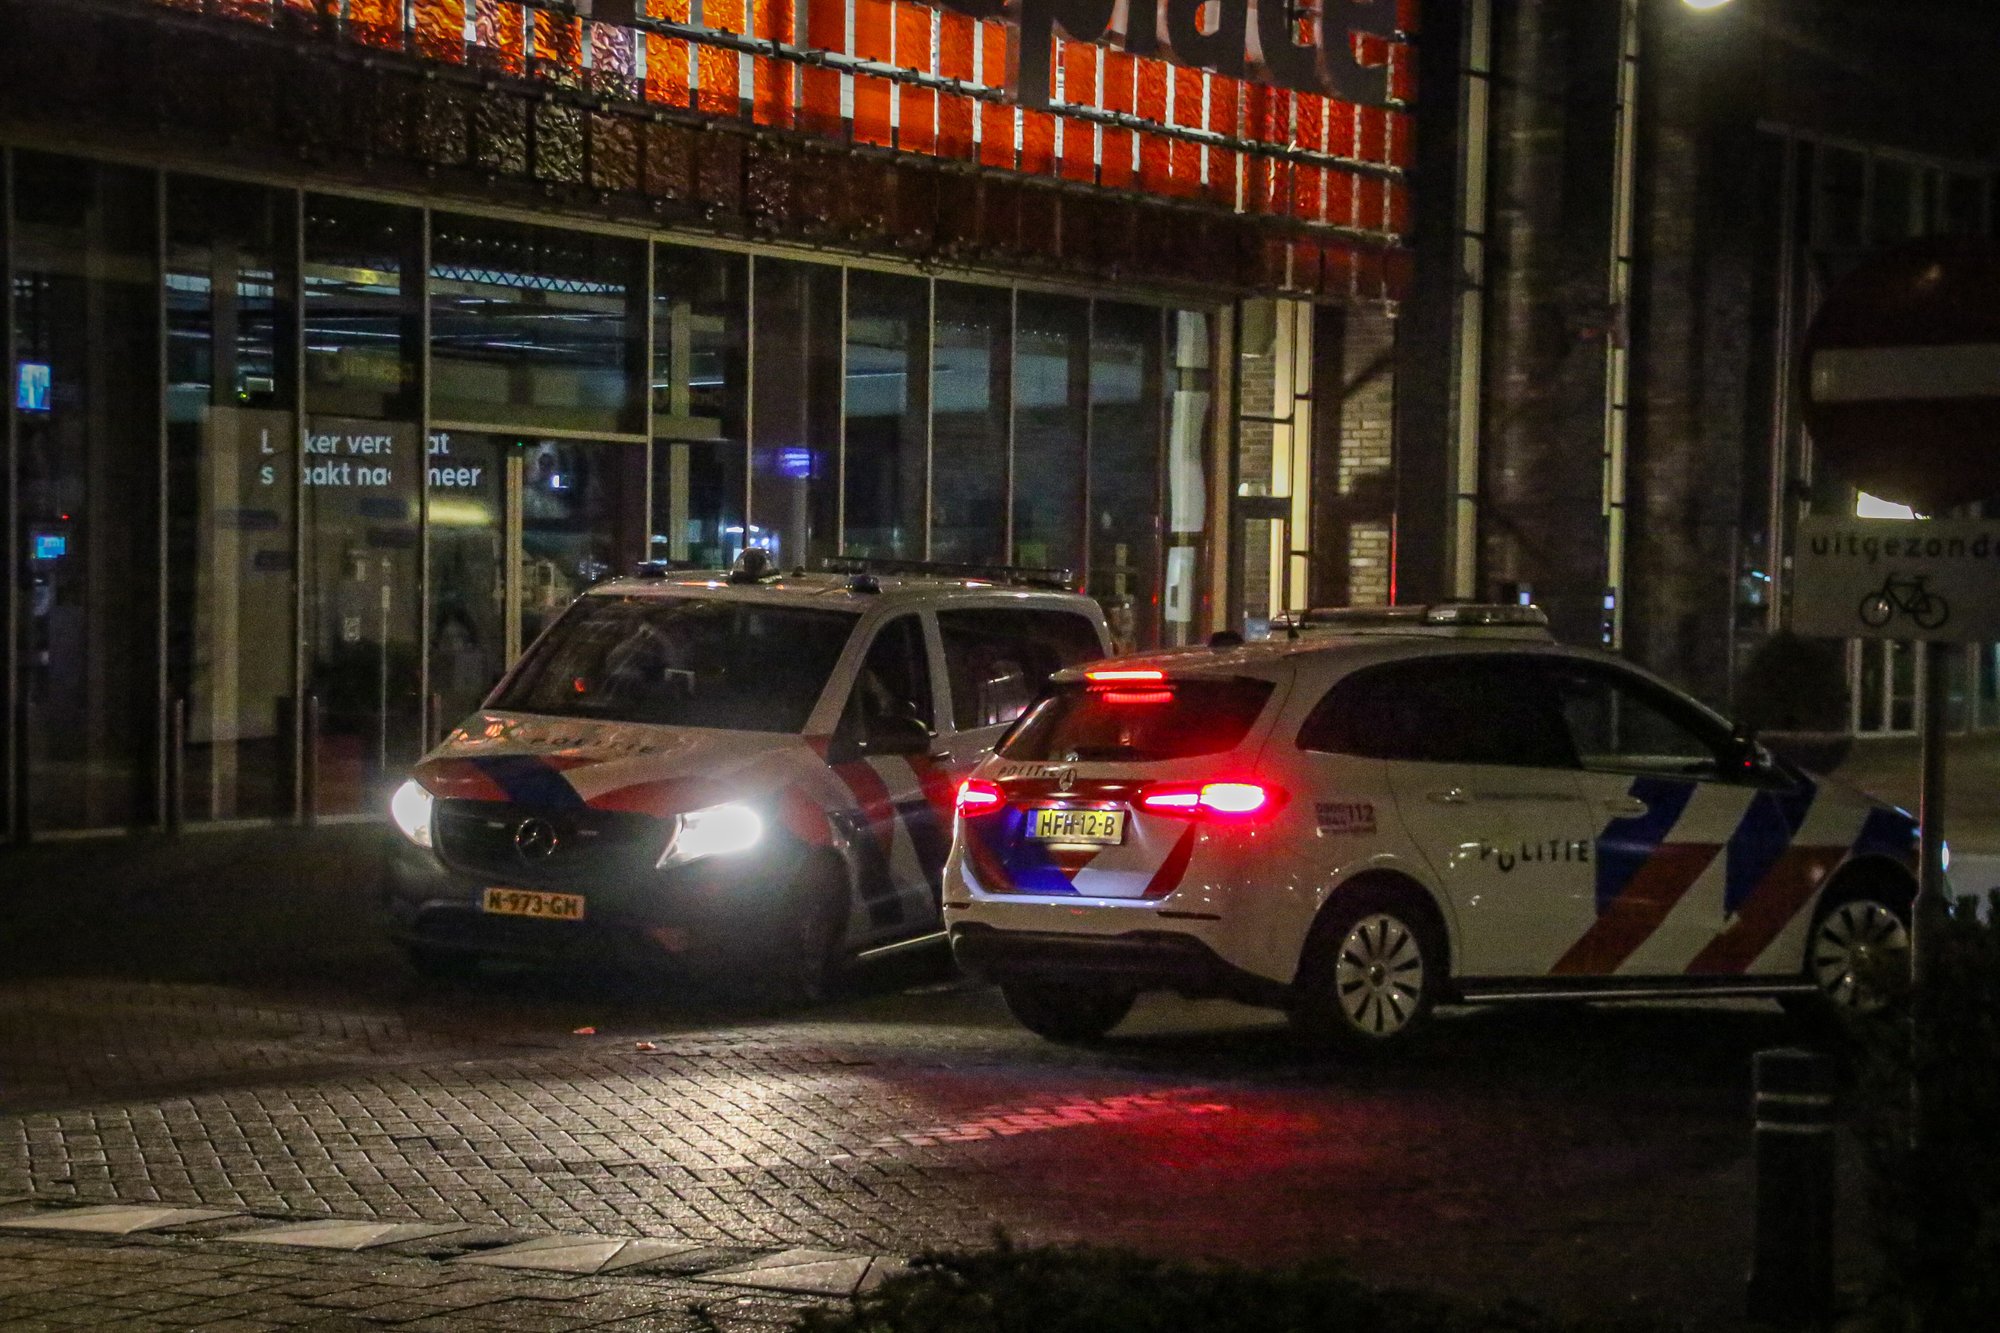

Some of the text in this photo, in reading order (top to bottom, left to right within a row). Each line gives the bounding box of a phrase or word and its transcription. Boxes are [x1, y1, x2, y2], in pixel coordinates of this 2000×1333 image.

[261, 429, 342, 454] Lker
[428, 432, 450, 455] at
[260, 460, 351, 486] sakt
[1348, 803, 1375, 822] 112
